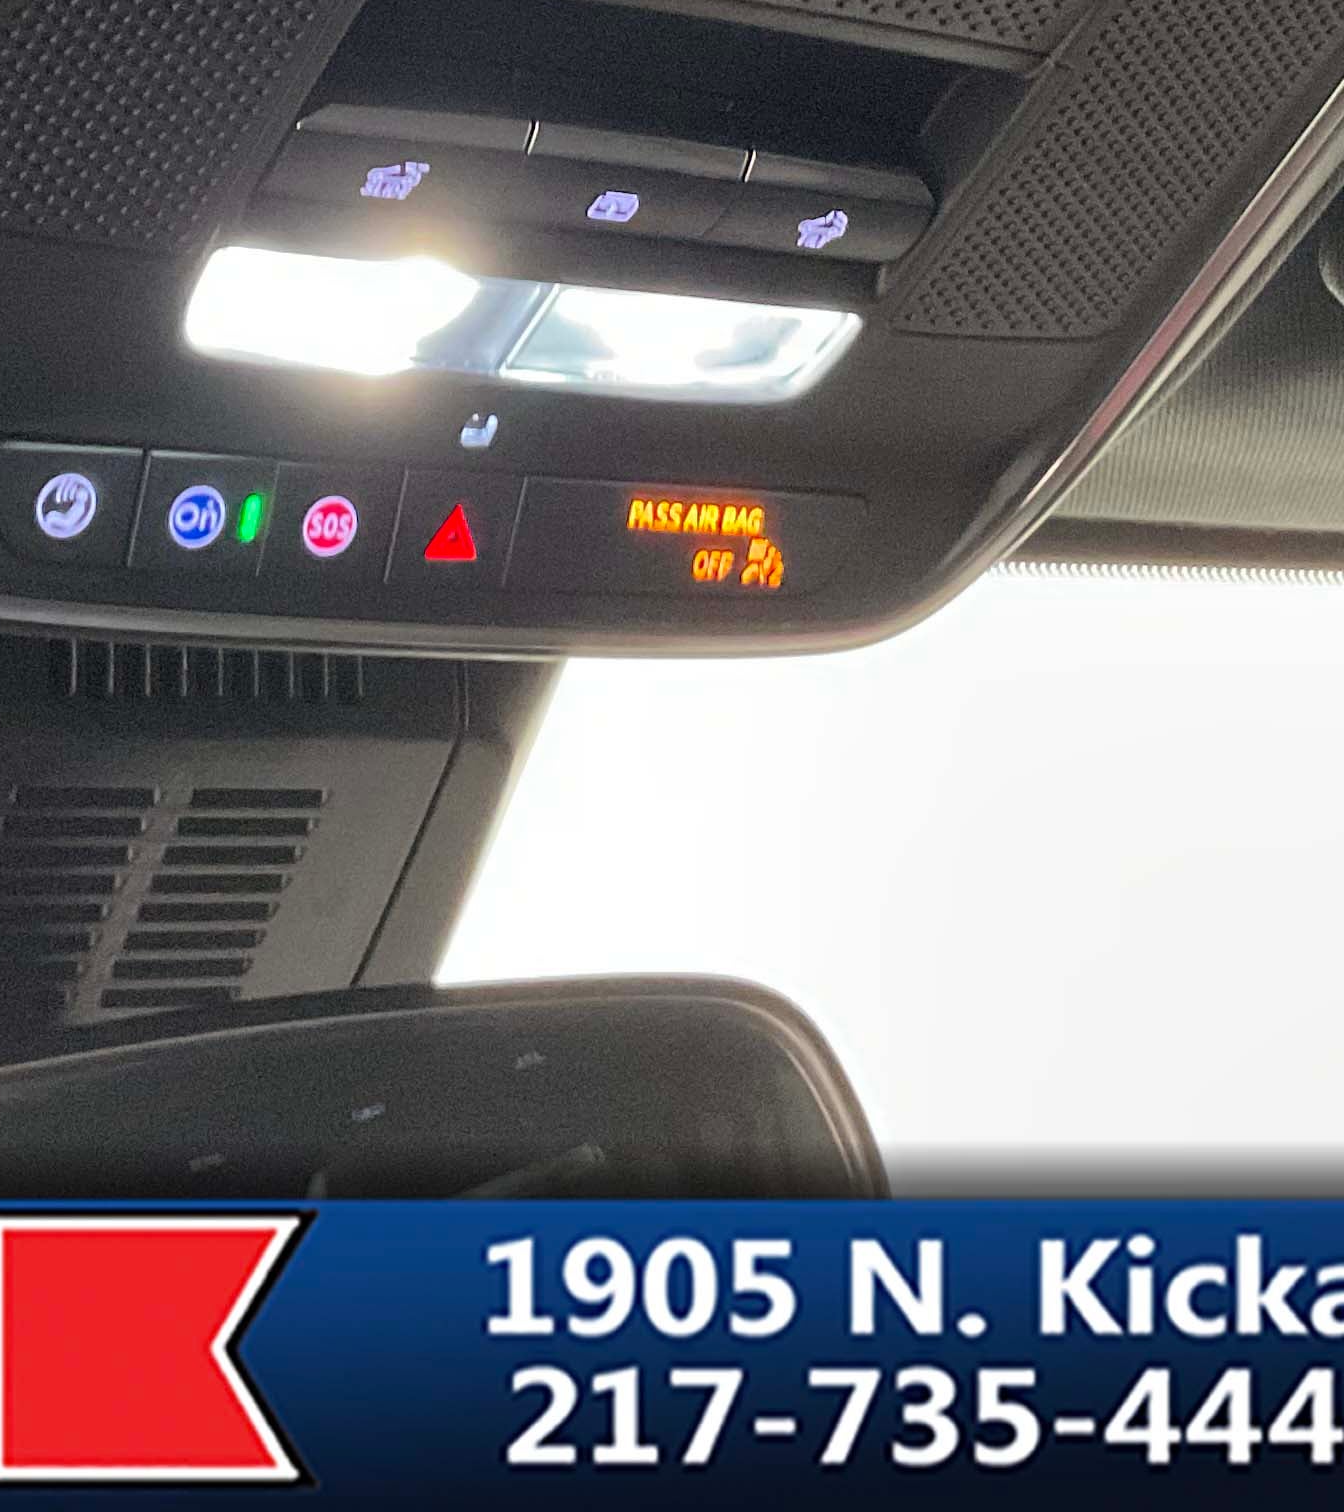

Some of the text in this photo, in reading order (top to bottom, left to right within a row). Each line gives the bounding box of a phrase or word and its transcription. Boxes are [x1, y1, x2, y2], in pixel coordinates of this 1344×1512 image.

[308, 512, 351, 540] SOS
[627, 499, 764, 536] PASS AIR BAG
[691, 549, 734, 581] OFF
